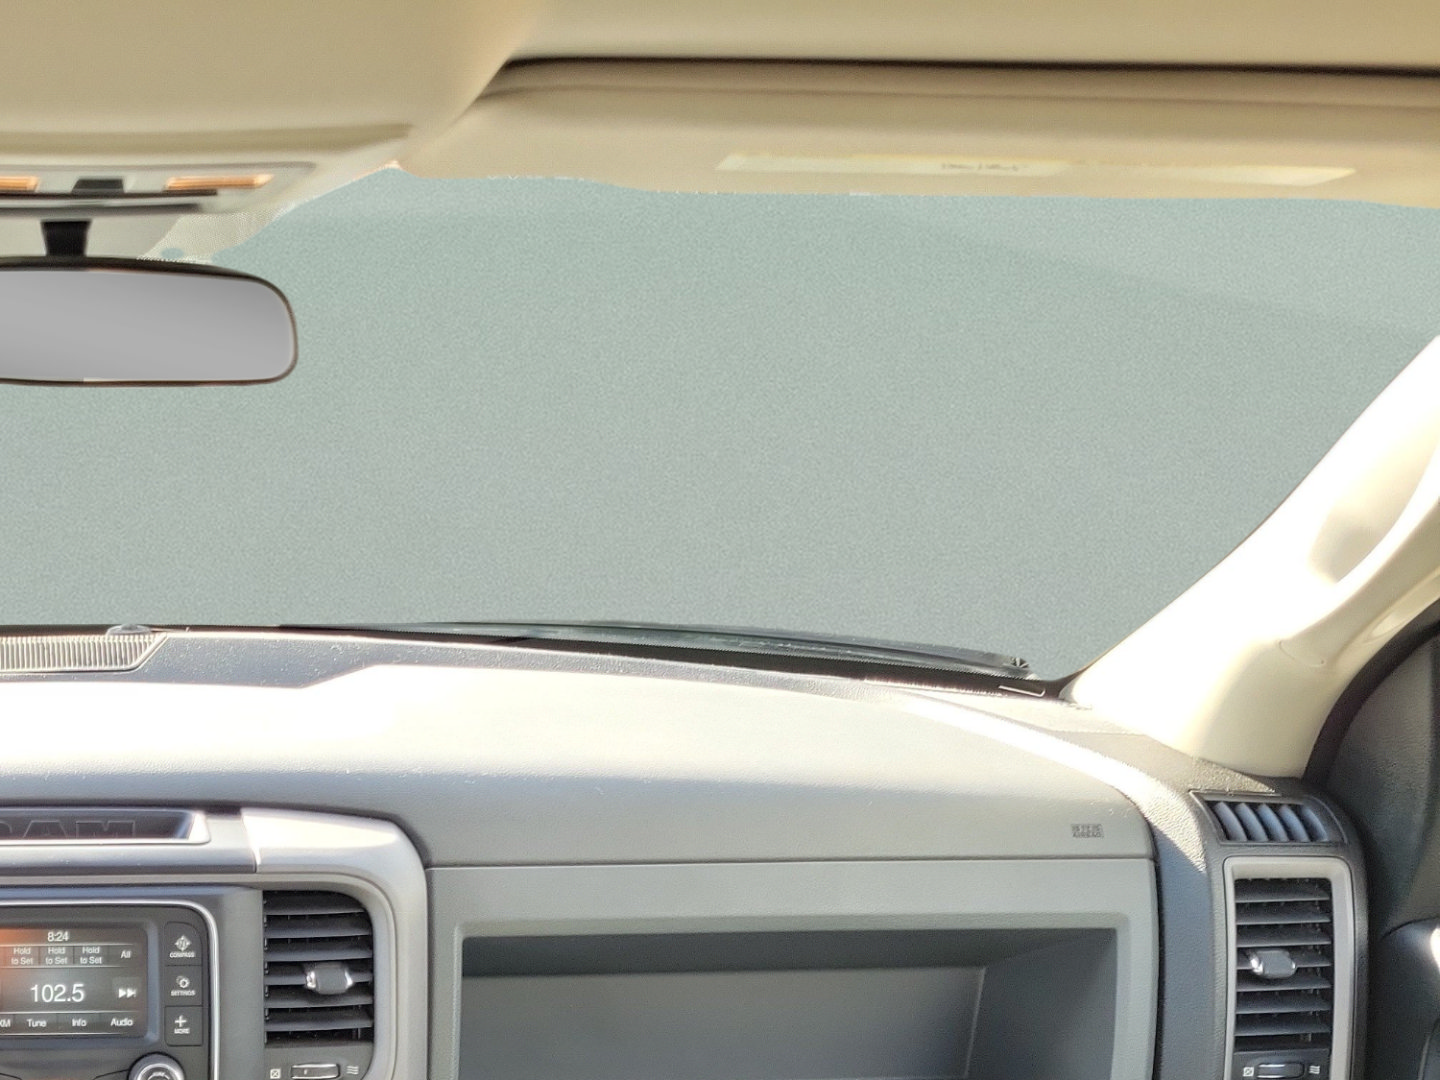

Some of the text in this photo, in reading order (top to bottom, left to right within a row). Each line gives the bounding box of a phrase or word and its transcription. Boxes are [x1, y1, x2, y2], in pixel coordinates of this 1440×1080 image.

[47, 931, 70, 942] 8:24
[13, 947, 30, 956] Hold
[48, 946, 65, 955] Hold
[83, 946, 100, 955] Hold
[11, 957, 34, 966] to Set
[46, 956, 69, 965] to Set
[81, 956, 104, 965] to Set
[30, 983, 85, 1003] 102.5
[27, 1018, 47, 1027] Tune
[72, 1018, 87, 1027] Info
[110, 1017, 134, 1027] Audio
